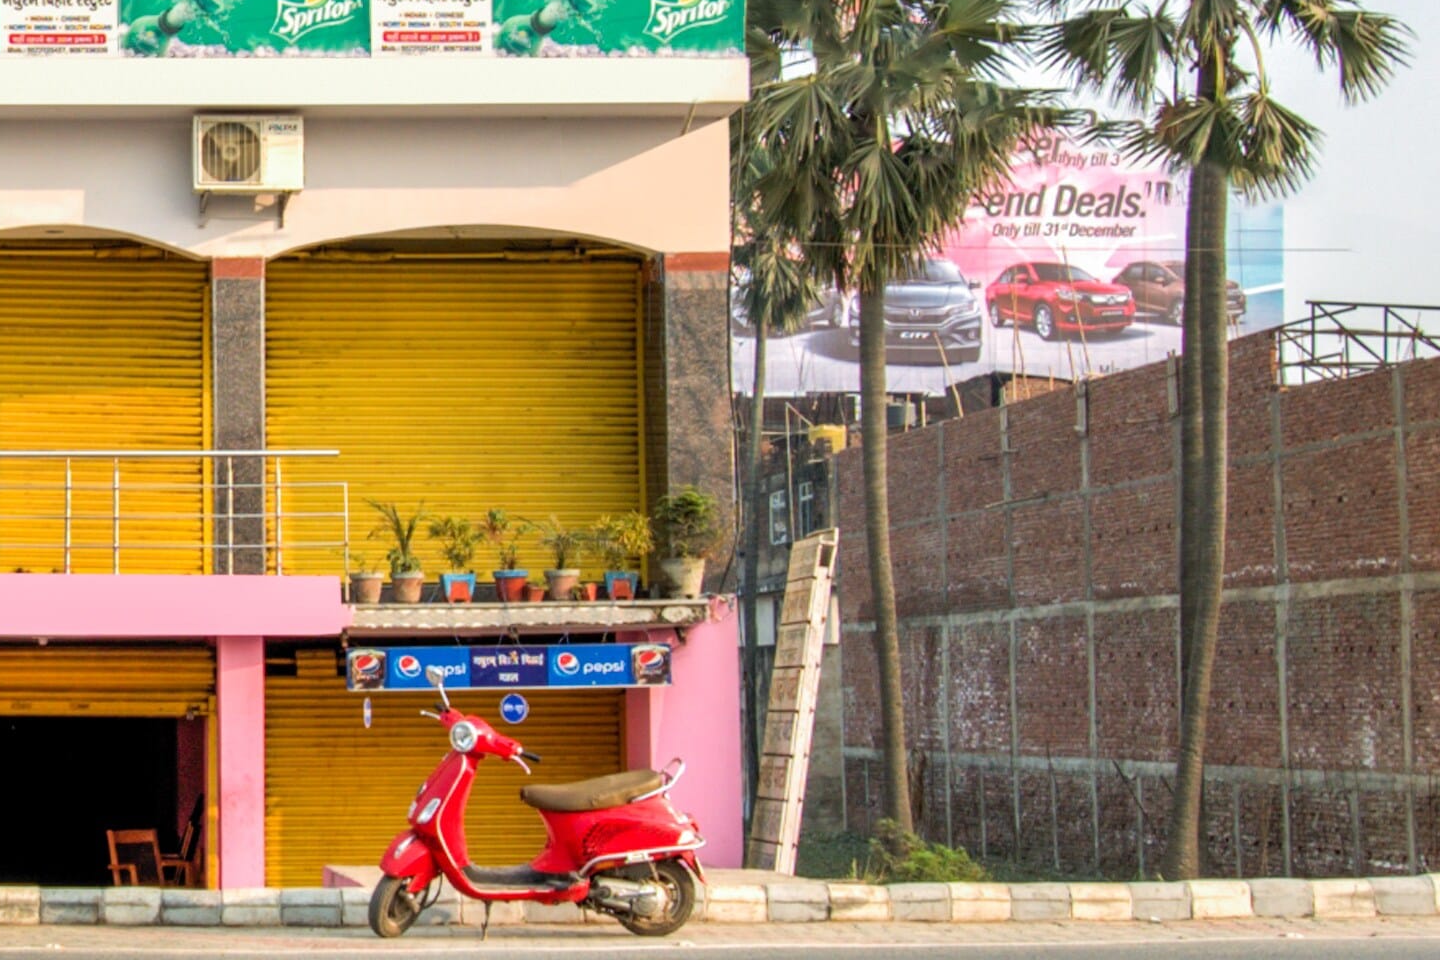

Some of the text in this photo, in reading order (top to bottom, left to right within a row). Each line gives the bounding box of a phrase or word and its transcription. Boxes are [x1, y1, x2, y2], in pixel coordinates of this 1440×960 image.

[1053, 185, 1146, 217] Deals.
[992, 223, 1021, 238] Only
[1024, 222, 1040, 235] till
[1069, 223, 1136, 237] December
[583, 660, 625, 677] pepsi
